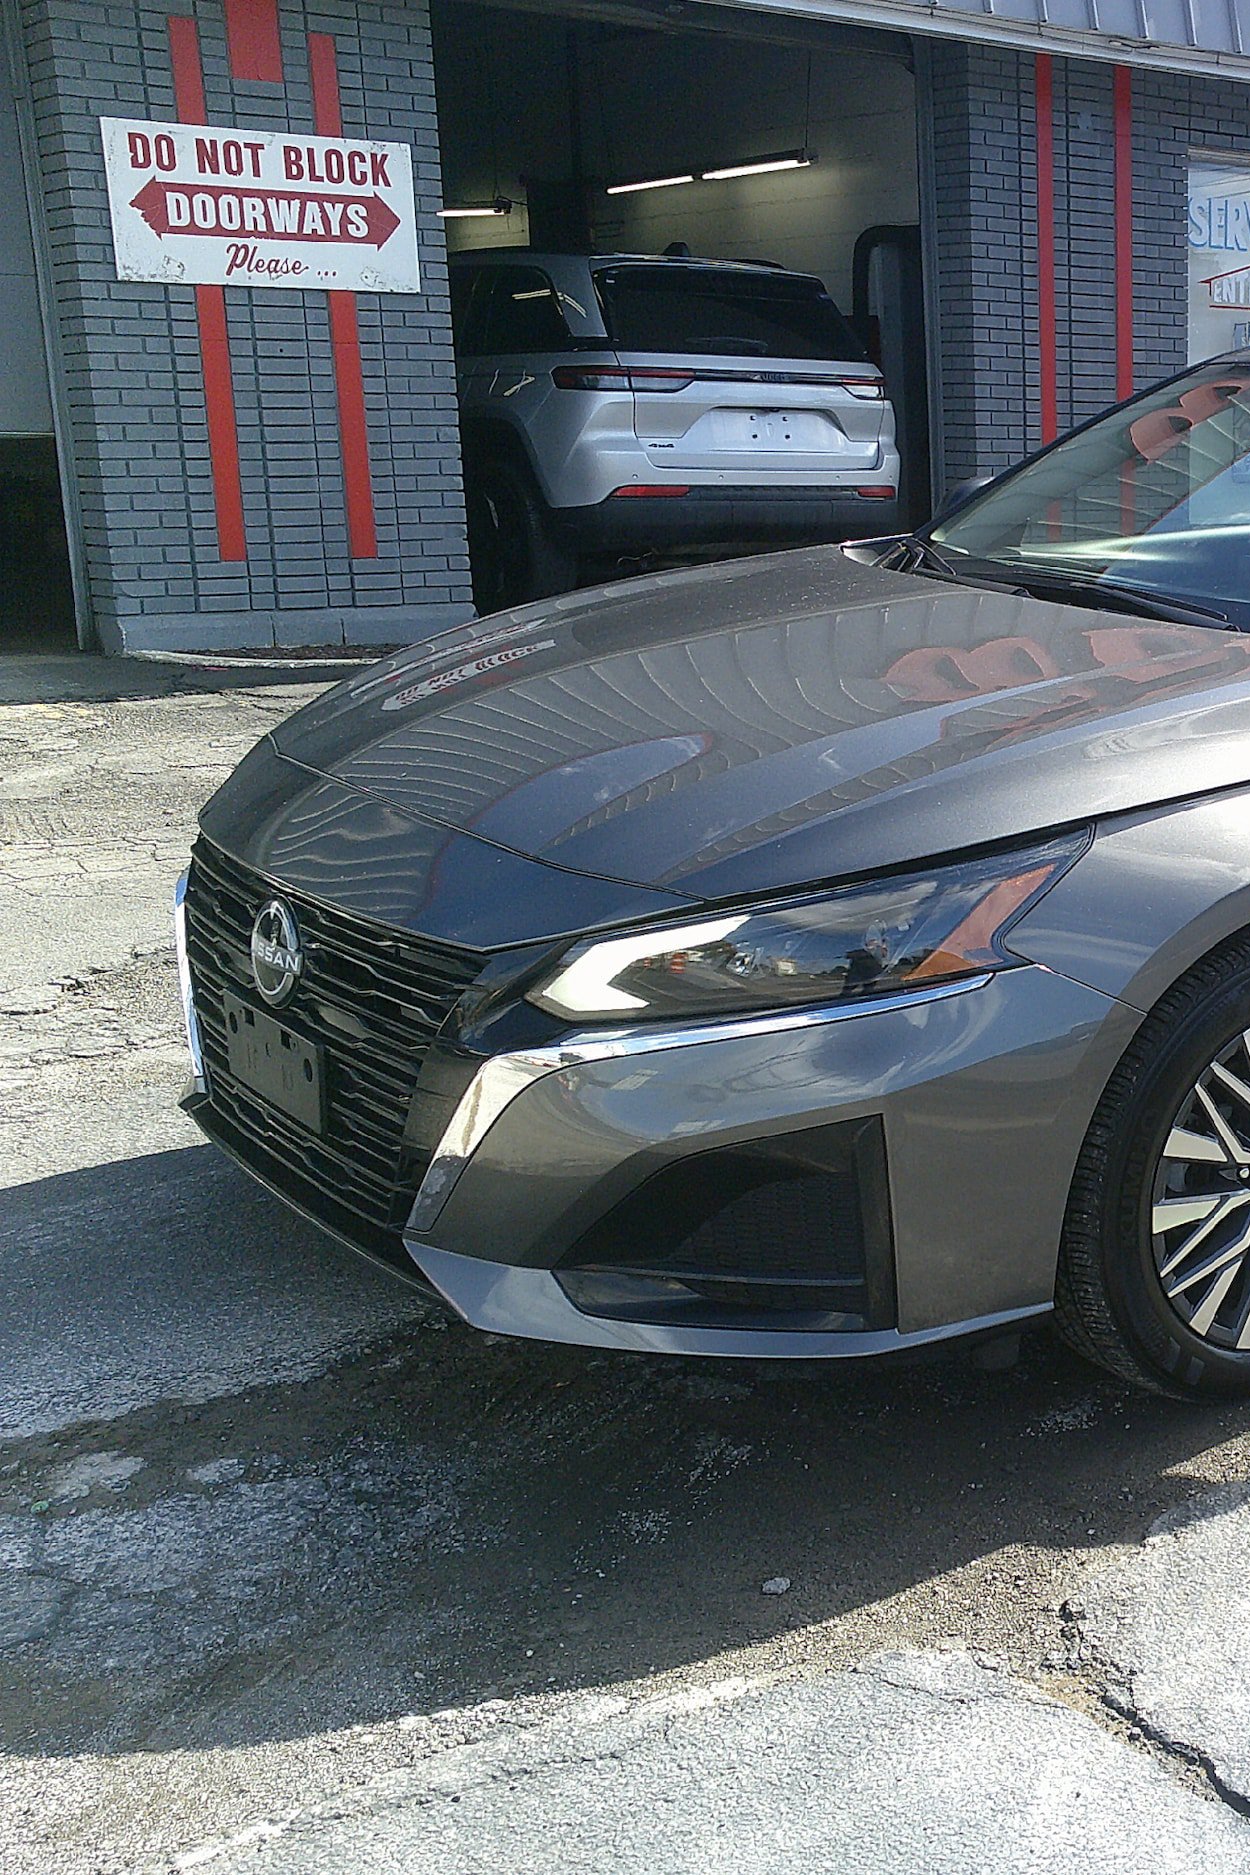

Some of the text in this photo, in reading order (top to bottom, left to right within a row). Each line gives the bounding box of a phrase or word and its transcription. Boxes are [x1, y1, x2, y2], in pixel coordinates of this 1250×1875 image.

[127, 132, 392, 188] DO NOT BLOCK
[165, 190, 370, 238] DOORWAYS
[225, 243, 310, 277] Please
[254, 938, 299, 972] SSAN
